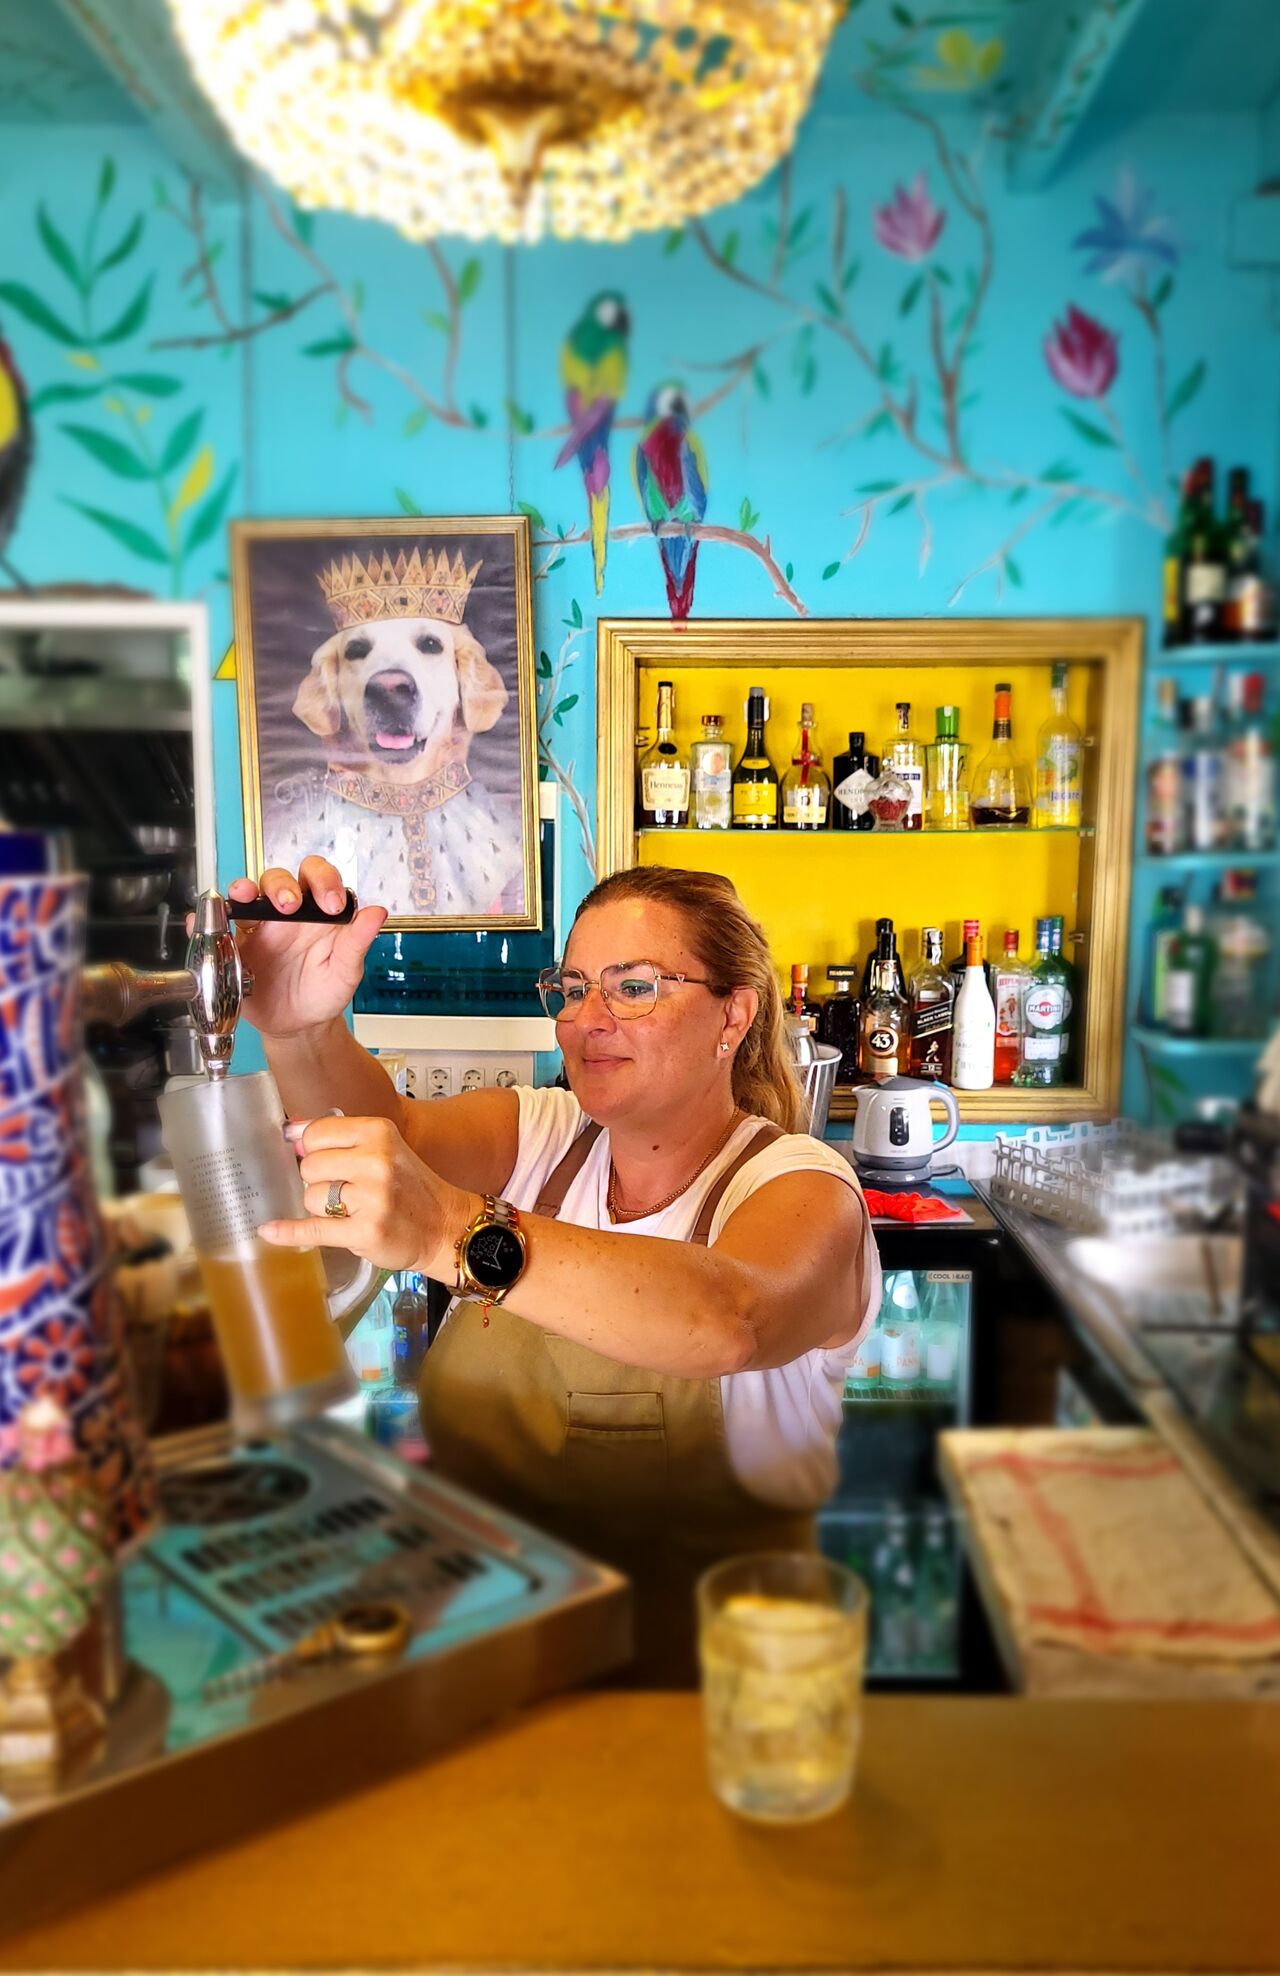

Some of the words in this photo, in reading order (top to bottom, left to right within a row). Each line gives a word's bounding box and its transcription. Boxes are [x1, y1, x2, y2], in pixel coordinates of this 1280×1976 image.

[650, 780, 683, 791] Hennessy
[1028, 1003, 1061, 1014] MARTINI
[872, 1033, 891, 1049] 43
